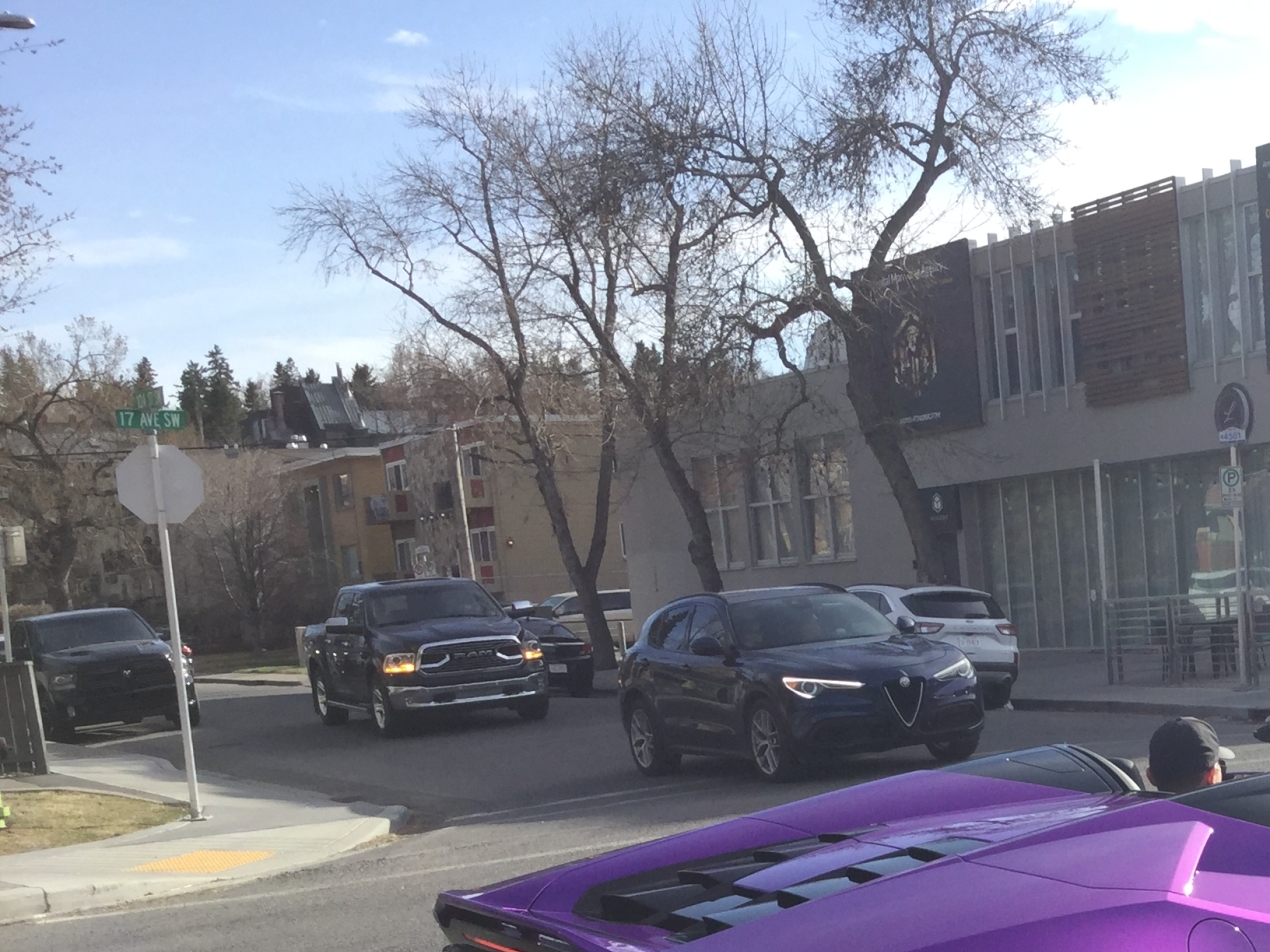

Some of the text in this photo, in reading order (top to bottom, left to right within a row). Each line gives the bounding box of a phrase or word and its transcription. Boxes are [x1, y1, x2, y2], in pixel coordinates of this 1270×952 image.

[119, 411, 181, 428] 17 AVE SW
